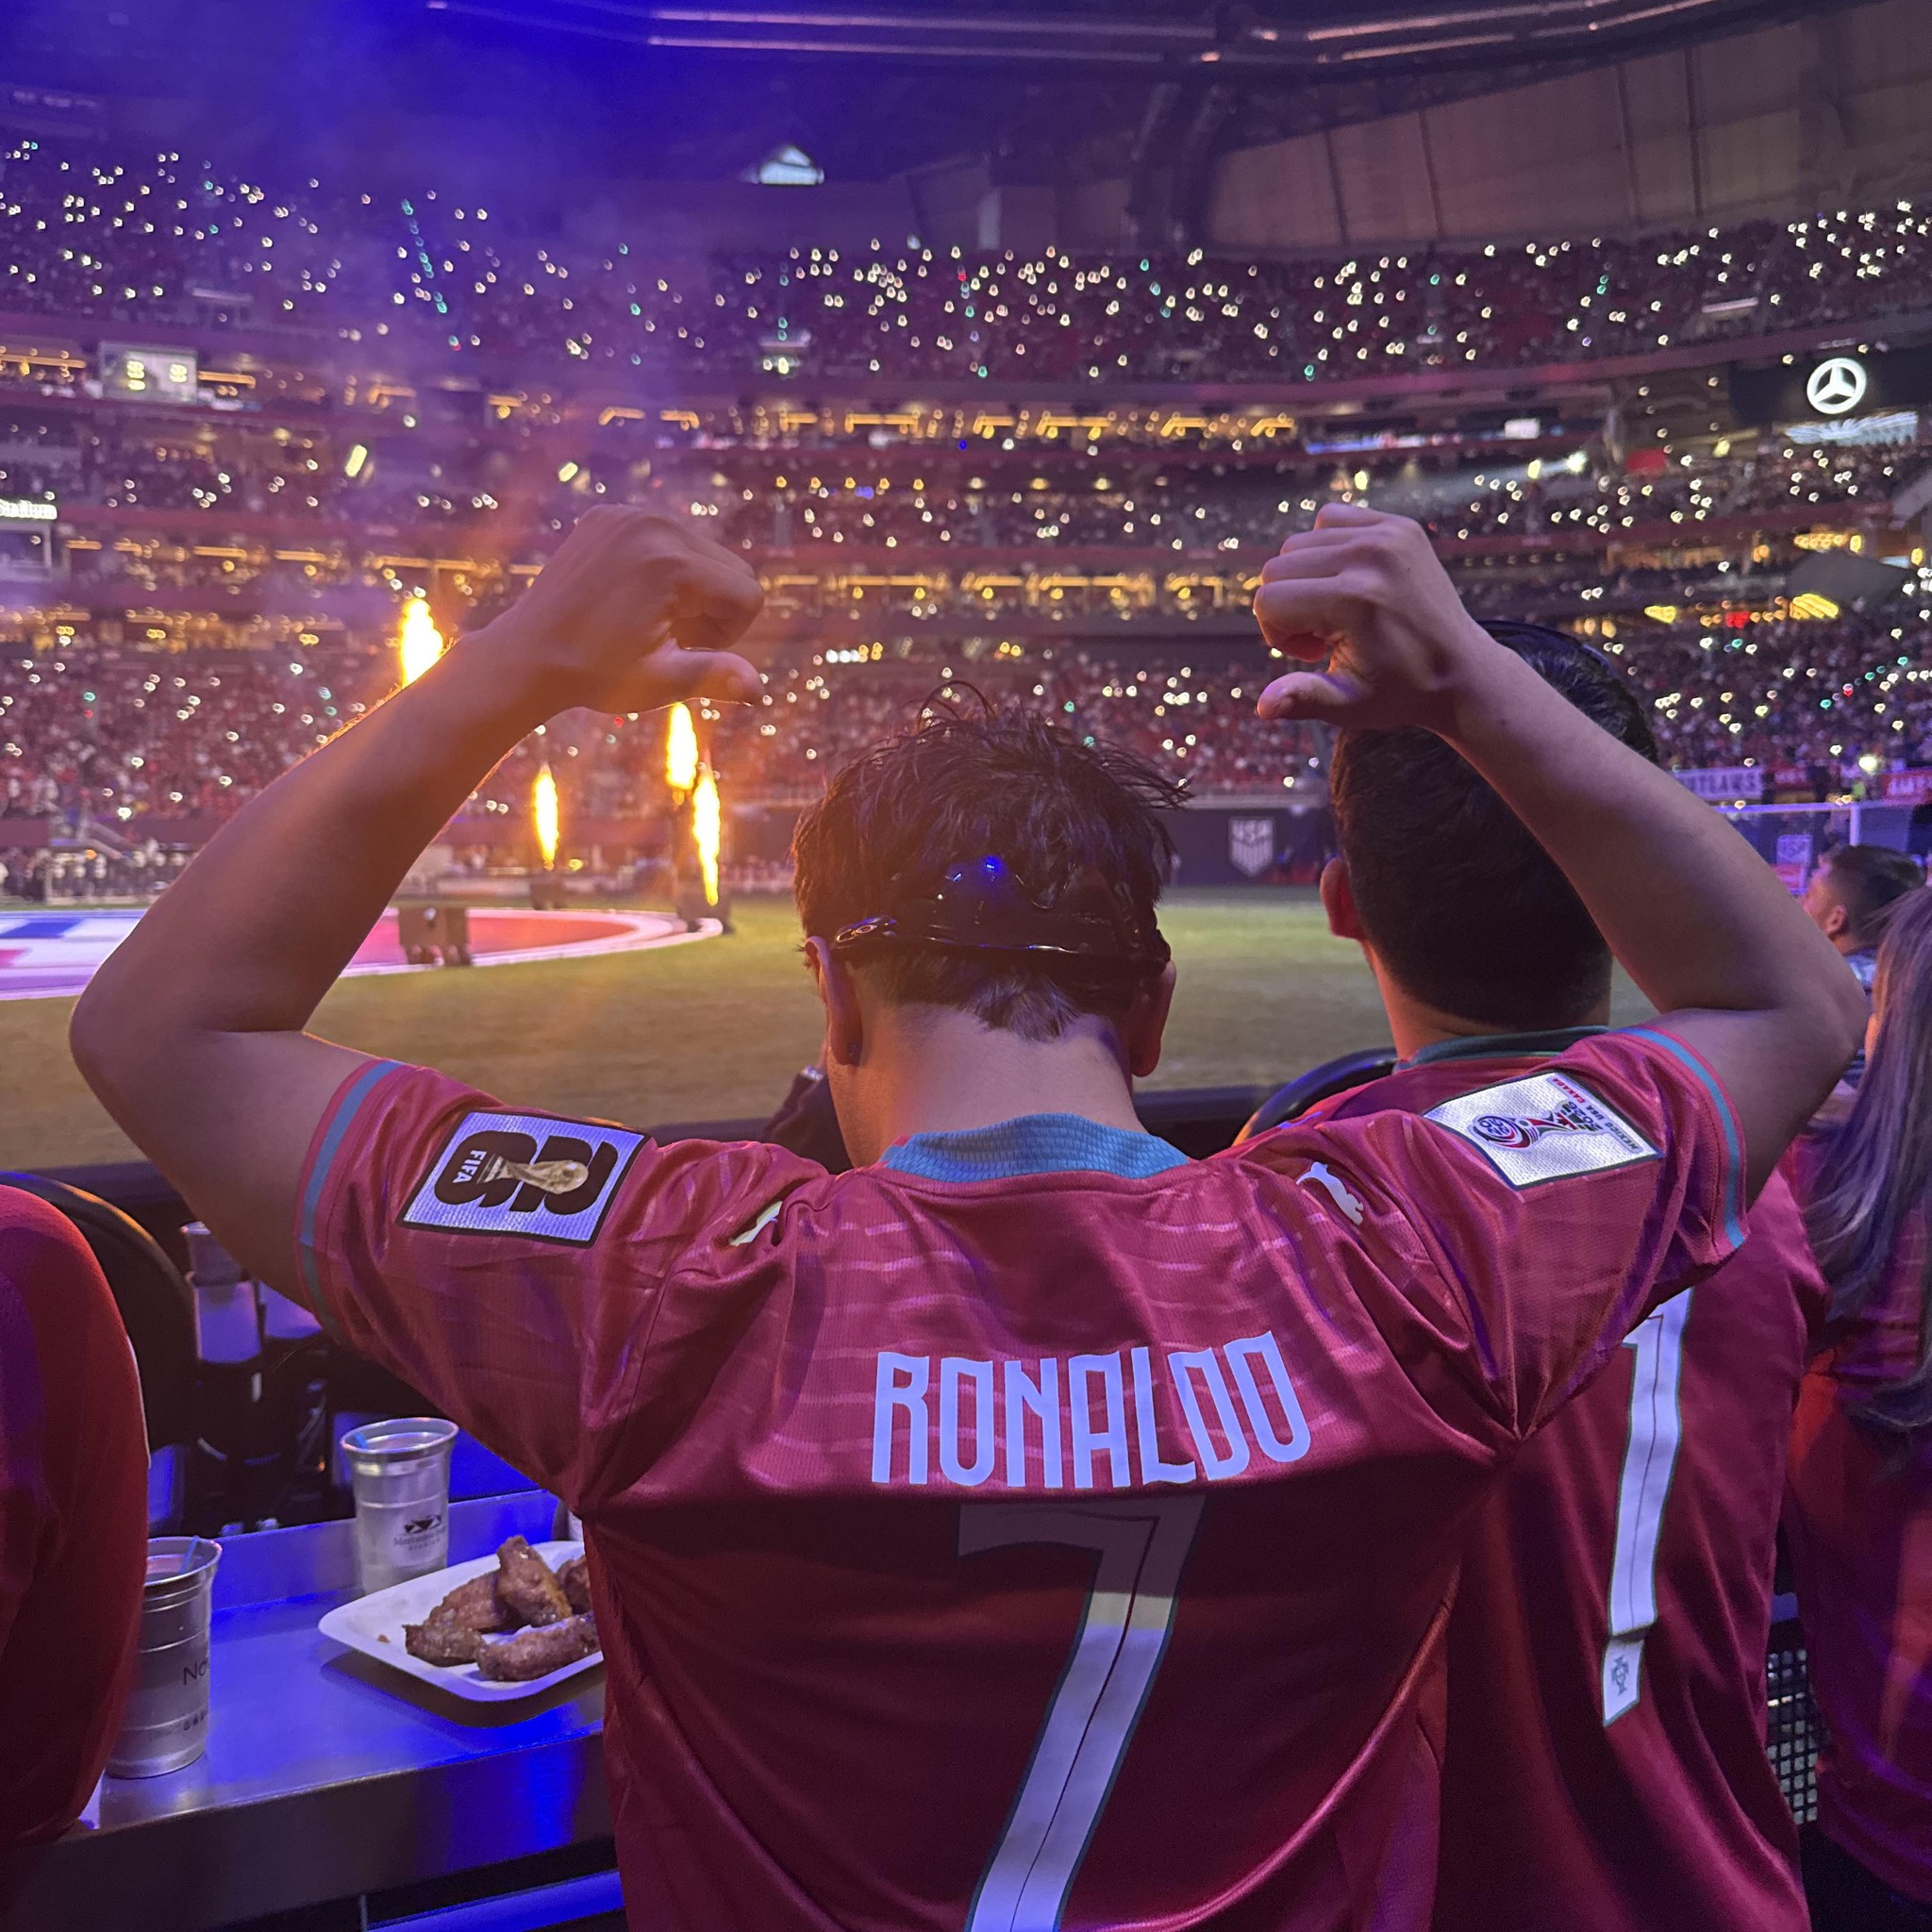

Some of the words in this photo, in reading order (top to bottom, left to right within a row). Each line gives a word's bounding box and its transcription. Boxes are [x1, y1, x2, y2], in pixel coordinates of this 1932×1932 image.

[1552, 1078, 1586, 1103] CANADA
[1568, 1101, 1604, 1131] 2026
[1586, 1105, 1605, 1120] USA
[1605, 1122, 1640, 1149] MEXICO
[453, 1150, 487, 1184] FIFA
[872, 1331, 1311, 1489] RONALDO
[958, 1494, 1206, 1932] 7
